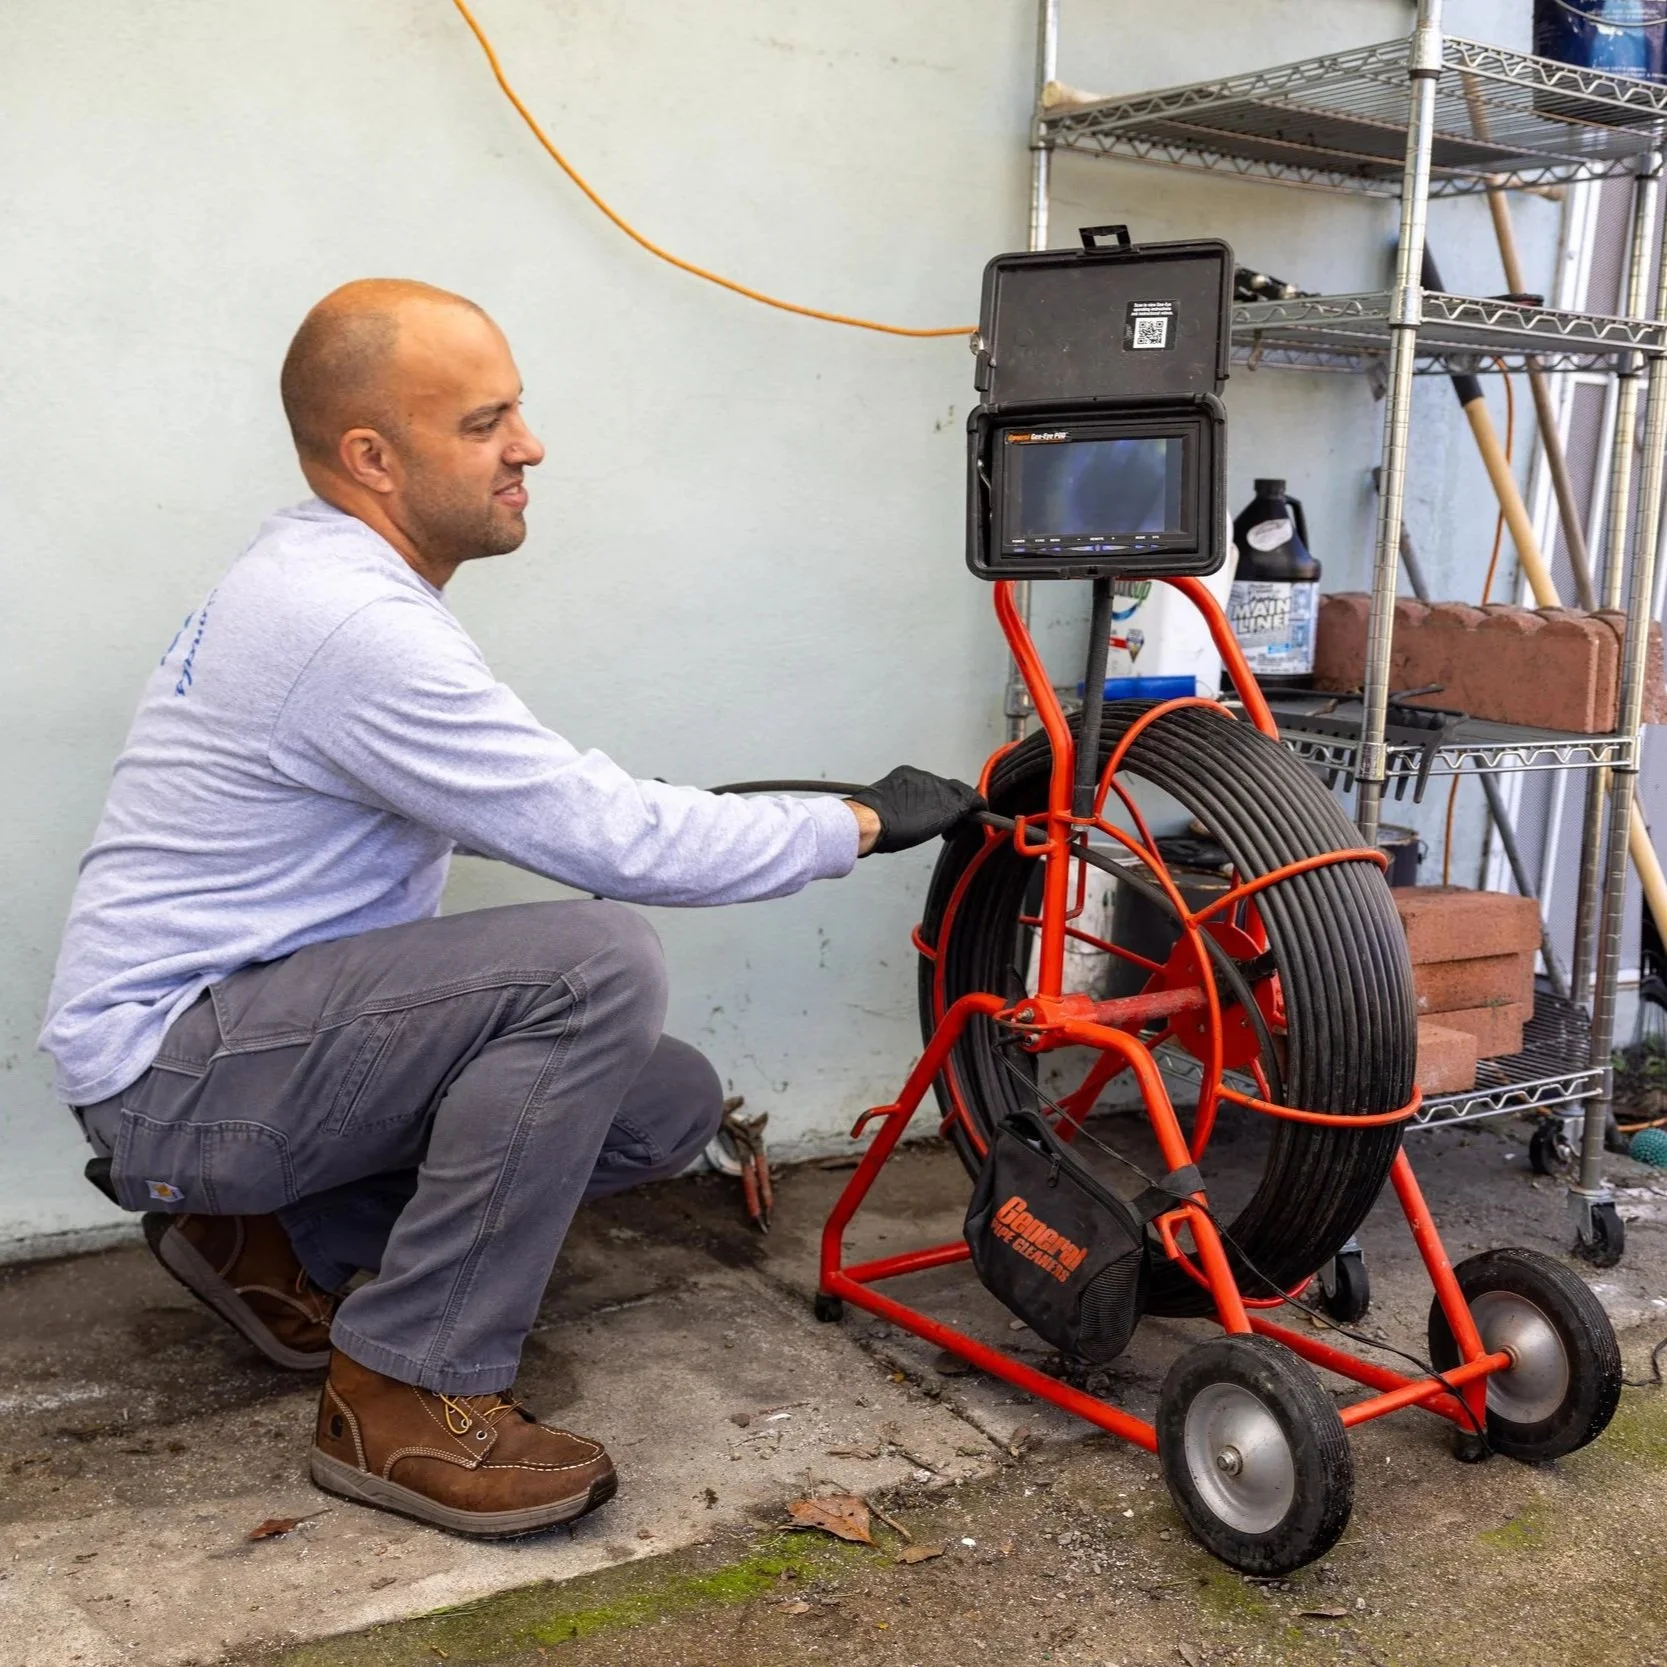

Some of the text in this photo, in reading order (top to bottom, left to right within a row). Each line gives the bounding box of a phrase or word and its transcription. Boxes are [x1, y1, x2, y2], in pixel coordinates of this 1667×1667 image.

[1233, 599, 1291, 620] MAIN
[991, 1217, 1071, 1283] PIPE CLEANERS
[995, 1195, 1088, 1273] General
